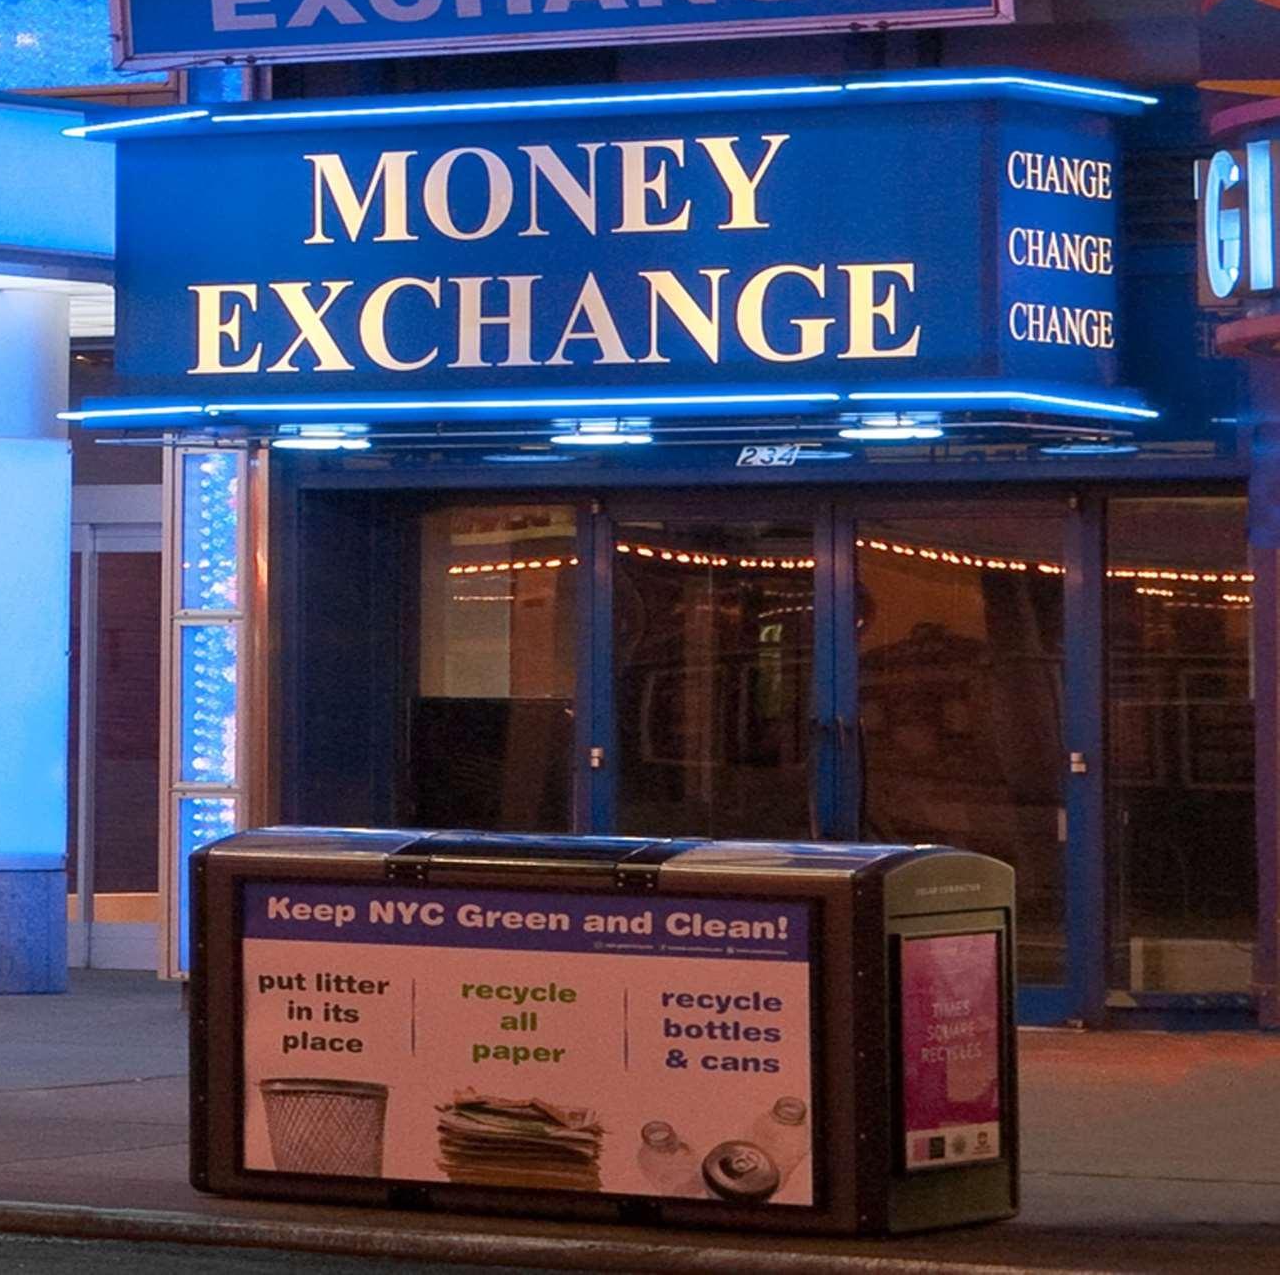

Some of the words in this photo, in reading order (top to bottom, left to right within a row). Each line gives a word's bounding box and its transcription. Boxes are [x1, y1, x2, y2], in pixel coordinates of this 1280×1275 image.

[1007, 150, 1113, 200] CHANGE
[303, 134, 790, 245] MONEY
[1008, 227, 1114, 276] CHANGE
[188, 262, 921, 376] EXCHANGE
[1009, 302, 1115, 350] CHANGE
[740, 446, 797, 466] 234
[267, 896, 356, 926] Keep
[369, 900, 445, 926] NYC
[457, 904, 571, 931] Green
[583, 911, 653, 935] and
[665, 912, 789, 940] Clean!
[257, 973, 307, 994] put
[316, 973, 391, 995] litter
[461, 982, 578, 1005] recycle
[287, 1000, 313, 1021] in
[323, 1002, 360, 1023] its
[661, 991, 783, 1014] recycle
[500, 1011, 538, 1032] all
[663, 1017, 782, 1043] bottles
[282, 1031, 364, 1054] place
[471, 1043, 566, 1066] paper
[665, 1048, 688, 1070] &
[701, 1054, 781, 1073] cans
